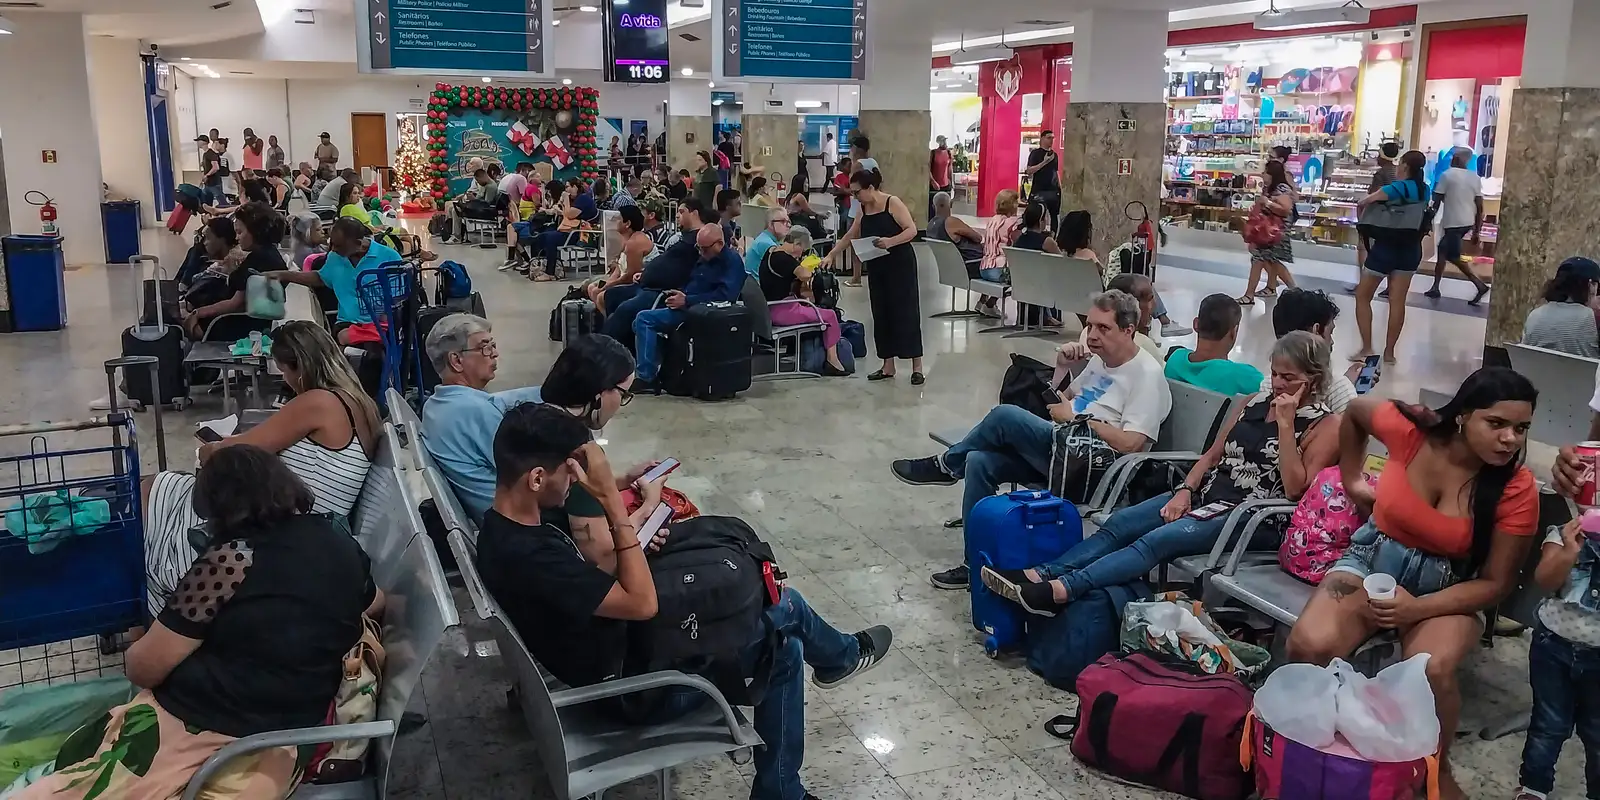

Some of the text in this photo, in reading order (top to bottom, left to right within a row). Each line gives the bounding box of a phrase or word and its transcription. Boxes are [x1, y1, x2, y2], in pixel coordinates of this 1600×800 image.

[398, 12, 430, 20] Sanitários
[620, 13, 661, 28] A vida
[398, 32, 429, 40] Telefones
[629, 65, 663, 79] 11:06
